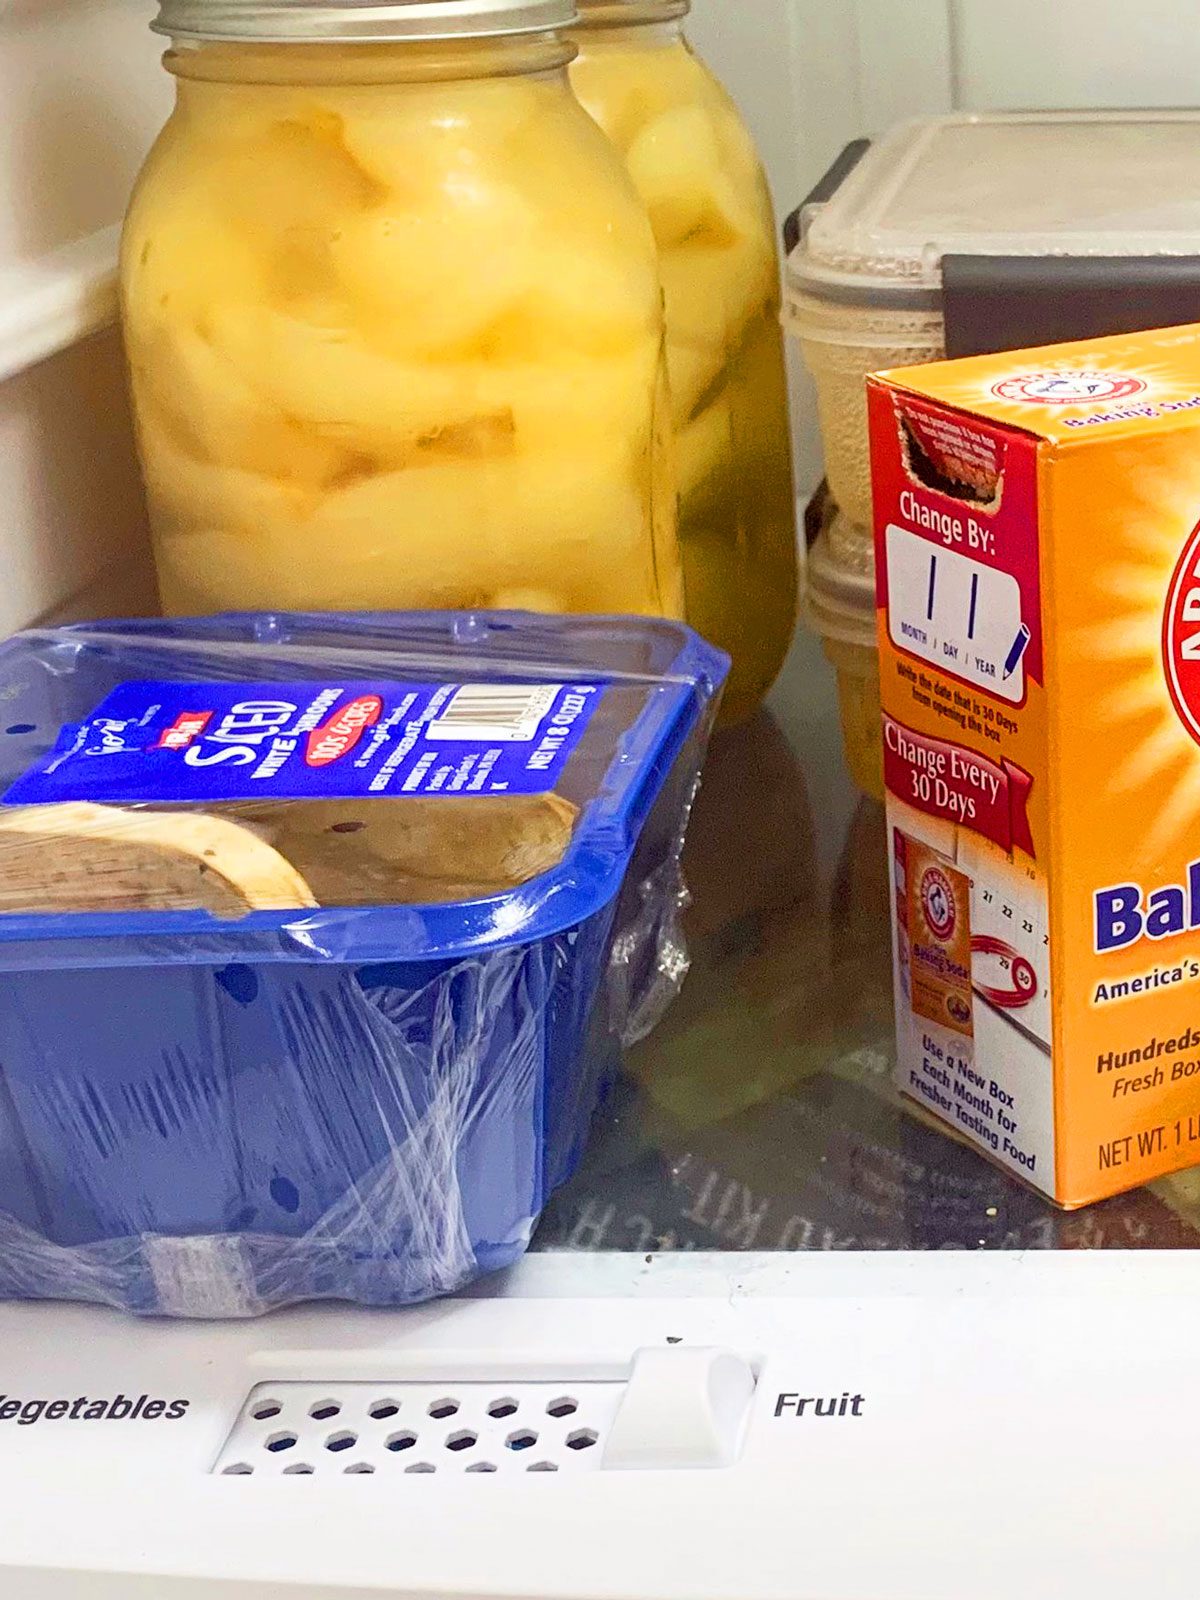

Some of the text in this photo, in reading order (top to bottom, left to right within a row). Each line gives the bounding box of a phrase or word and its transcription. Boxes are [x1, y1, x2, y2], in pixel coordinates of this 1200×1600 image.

[900, 491, 962, 545] Change
[901, 621, 995, 678] MONTH DAY YEAR
[912, 687, 1000, 743] from opening the box
[919, 675, 931, 691] the
[934, 681, 952, 701] date
[954, 690, 971, 710] that
[973, 700, 981, 716] is
[982, 706, 994, 722] 30
[996, 711, 1018, 734] Days
[250, 737, 297, 779] WHITE
[284, 688, 344, 736] SHROOMS
[523, 750, 559, 769] NET
[885, 722, 1000, 804] Change Every
[911, 770, 976, 822] 30 Days
[983, 890, 1033, 933] 21 22 23
[999, 957, 1029, 984] 29 30
[1094, 959, 1199, 1003] America's
[922, 1034, 1015, 1109] Use a New Box
[1097, 1027, 1200, 1073] Hundreds
[923, 1057, 1018, 1134] Each Month for
[1112, 1068, 1164, 1098] Fresh
[909, 1071, 1035, 1171] Fresher Tasting Food
[1099, 1138, 1134, 1170] NET
[1138, 1129, 1167, 1160] WT.
[1174, 1120, 1182, 1145] 1
[774, 1392, 864, 1418] Fruit
